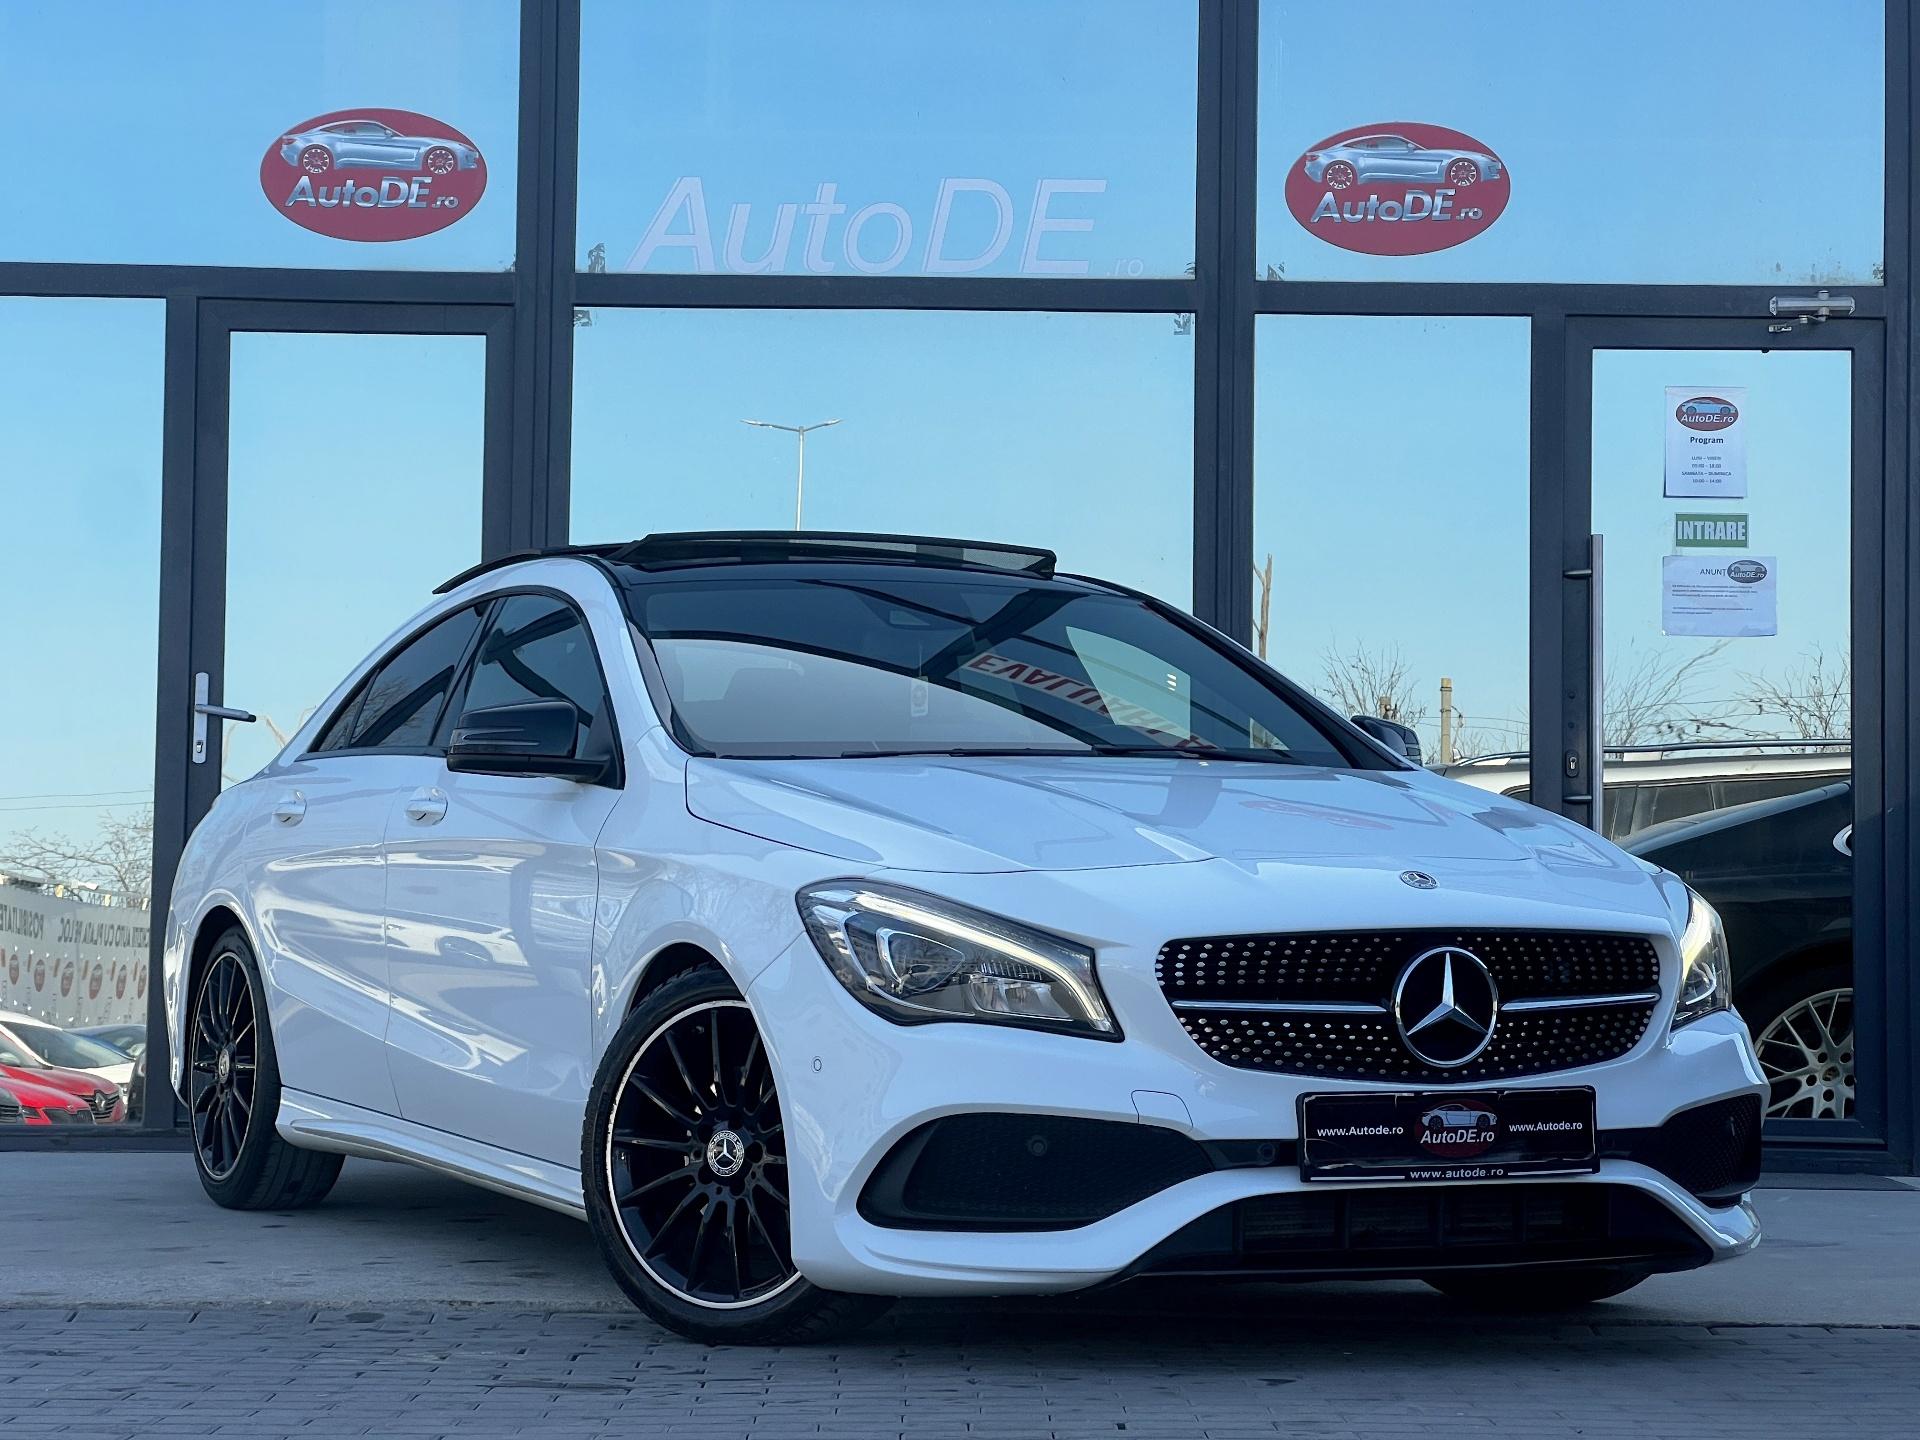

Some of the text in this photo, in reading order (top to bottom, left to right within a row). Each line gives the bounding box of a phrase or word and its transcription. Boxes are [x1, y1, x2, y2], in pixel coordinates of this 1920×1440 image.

[1681, 413, 1735, 424] AutoDE.ro
[1690, 436, 1724, 445] Program
[1677, 520, 1746, 541] INTRARE
[1317, 1125, 1404, 1137] www.Autode.ro
[1509, 1121, 1583, 1132] www.Autode.ro
[1420, 1129, 1495, 1145] AutoDE.ro
[1410, 1167, 1504, 1179] www.autode.ro
